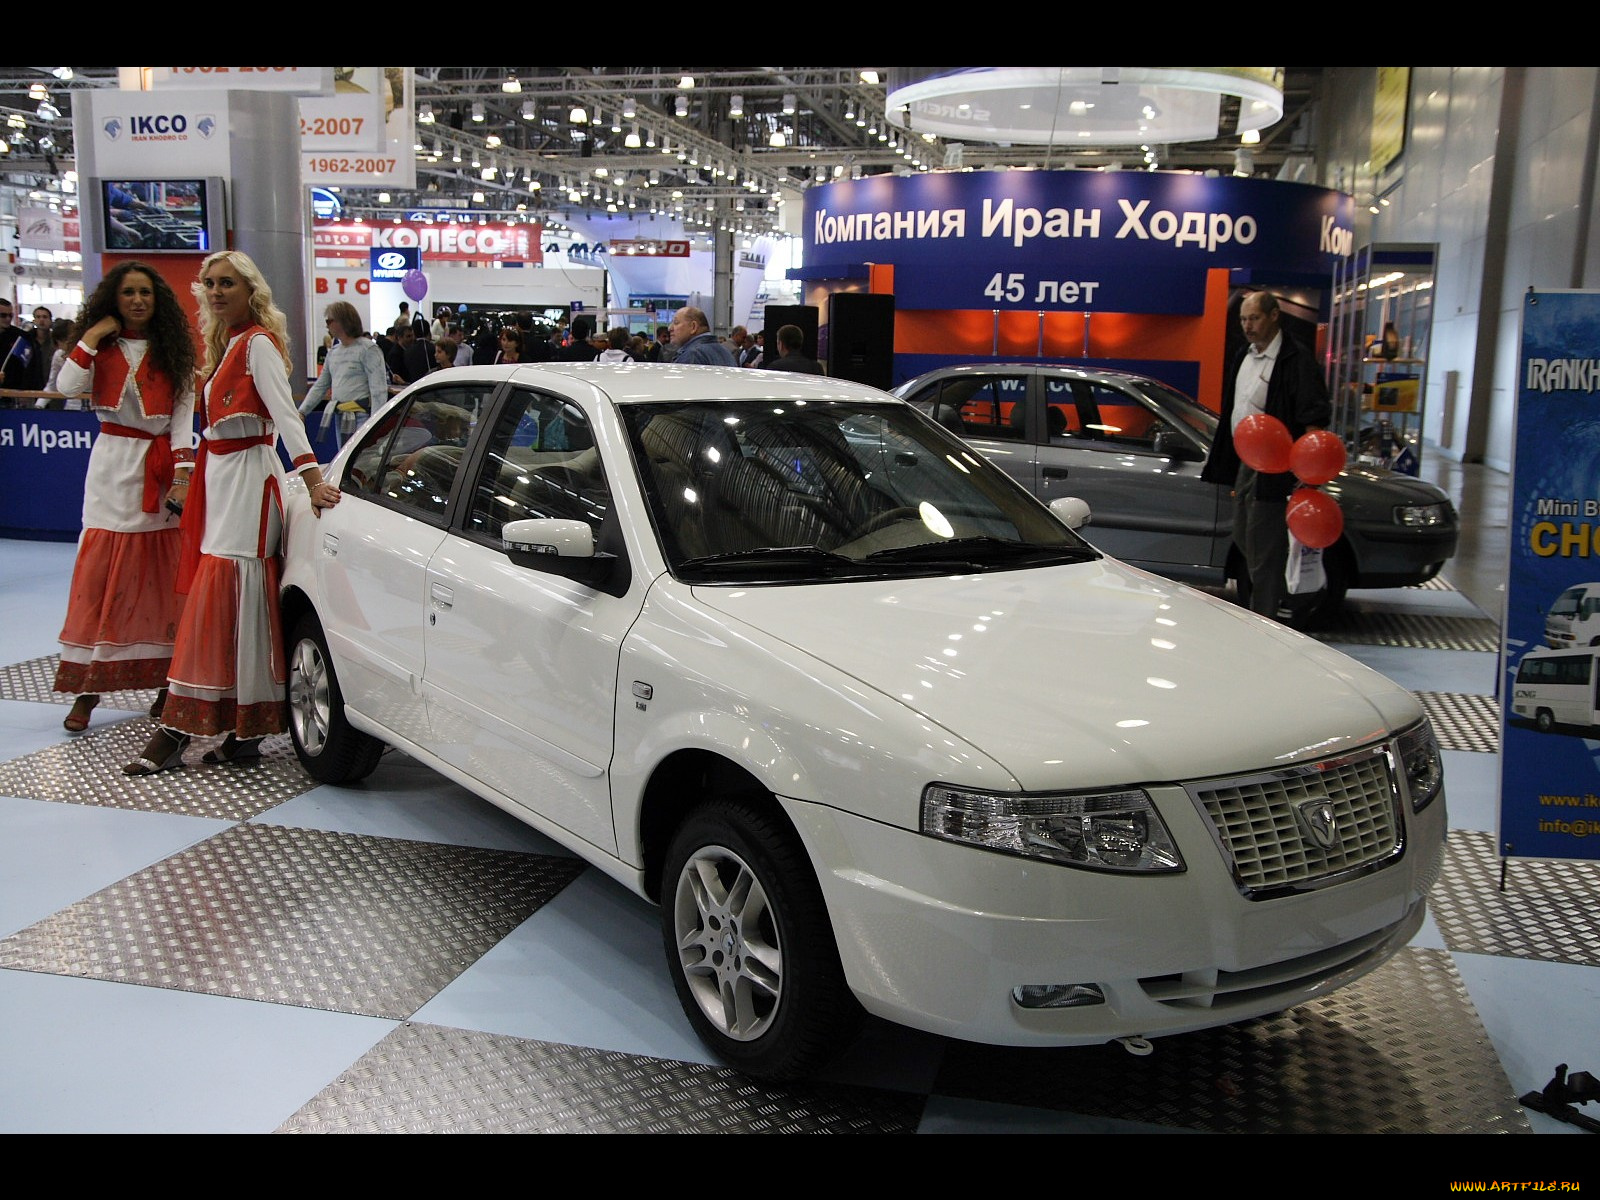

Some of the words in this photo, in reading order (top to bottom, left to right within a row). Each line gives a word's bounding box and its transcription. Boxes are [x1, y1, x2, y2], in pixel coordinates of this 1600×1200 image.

[130, 114, 187, 134] IKCO
[309, 158, 397, 173] 1962-2007
[815, 207, 966, 245] Компания
[981, 198, 1101, 247] Иран
[1114, 199, 1258, 252] Ходро
[371, 228, 501, 254] КОЛЕСО
[984, 273, 1025, 302] 45
[1035, 281, 1099, 303] лет
[21, 423, 92, 453] Иран
[1537, 499, 1578, 517] Mini
[1584, 500, 1600, 517] B
[1515, 689, 1536, 699] CNG
[1539, 794, 1600, 807] www.ik
